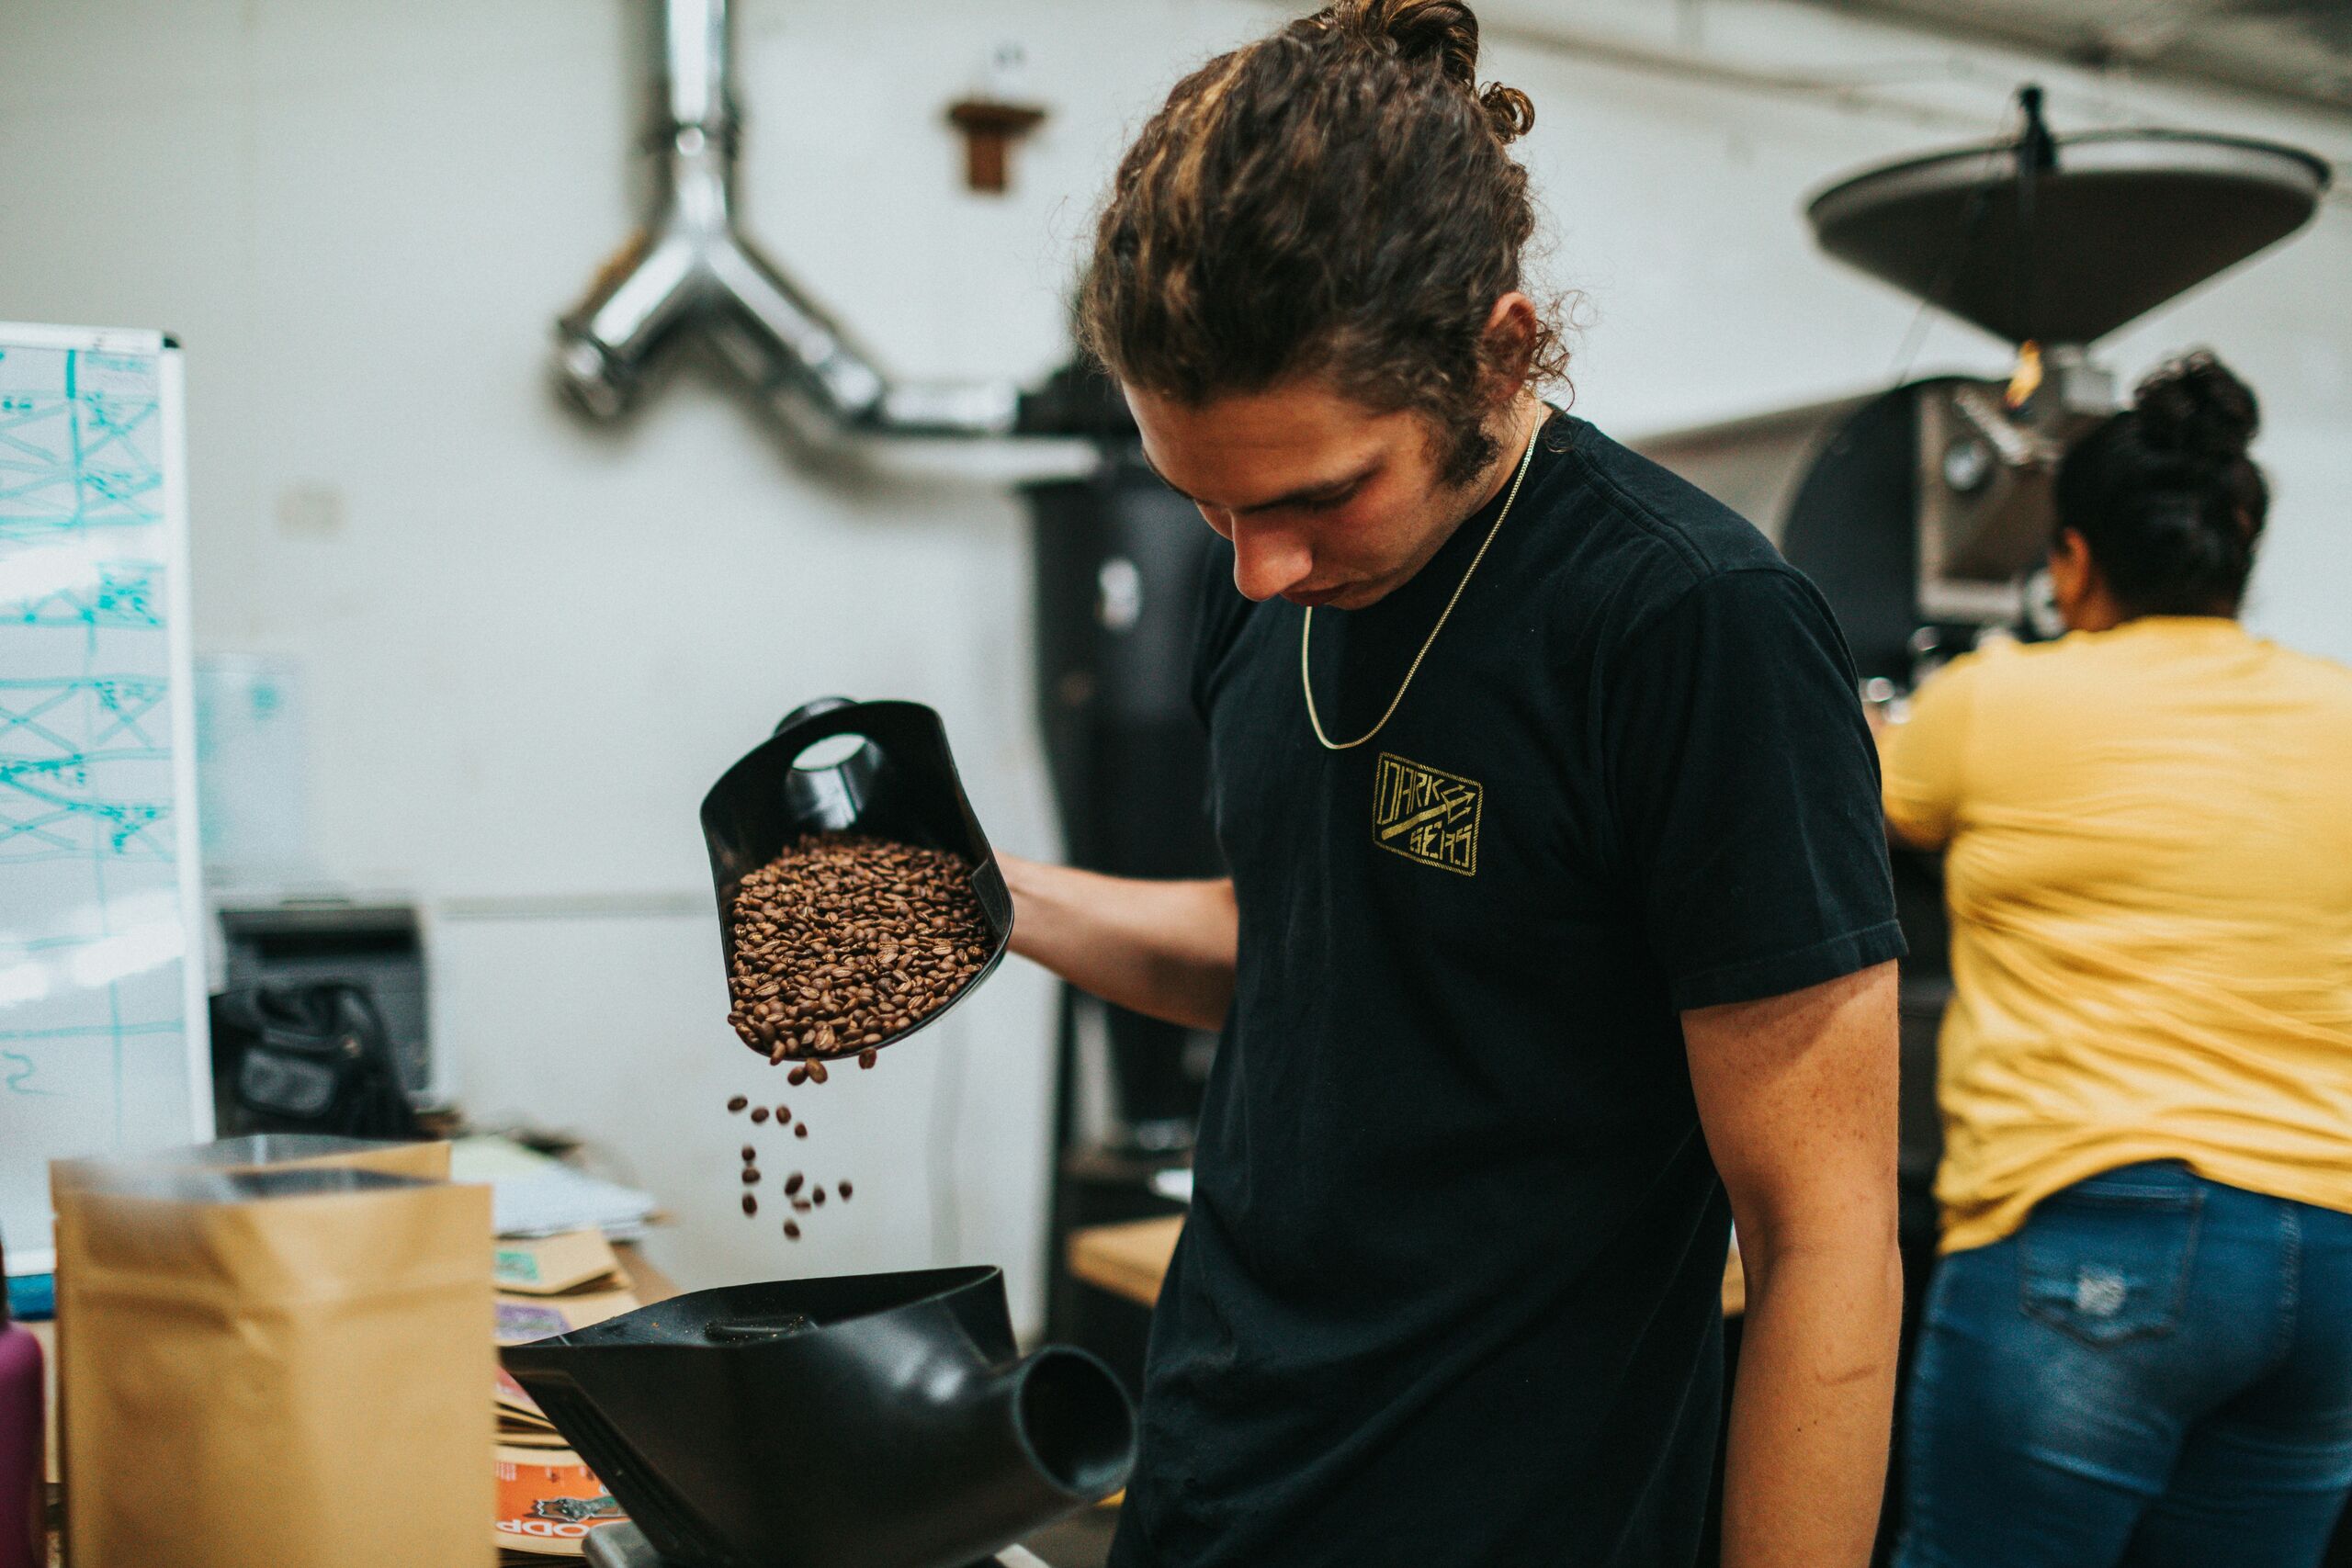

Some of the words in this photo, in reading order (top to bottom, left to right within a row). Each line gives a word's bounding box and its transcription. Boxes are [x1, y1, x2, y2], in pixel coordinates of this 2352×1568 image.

[1376, 761, 1445, 825] DARK
[1409, 819, 1473, 868] SEAS
[496, 1519, 590, 1537] ODP
